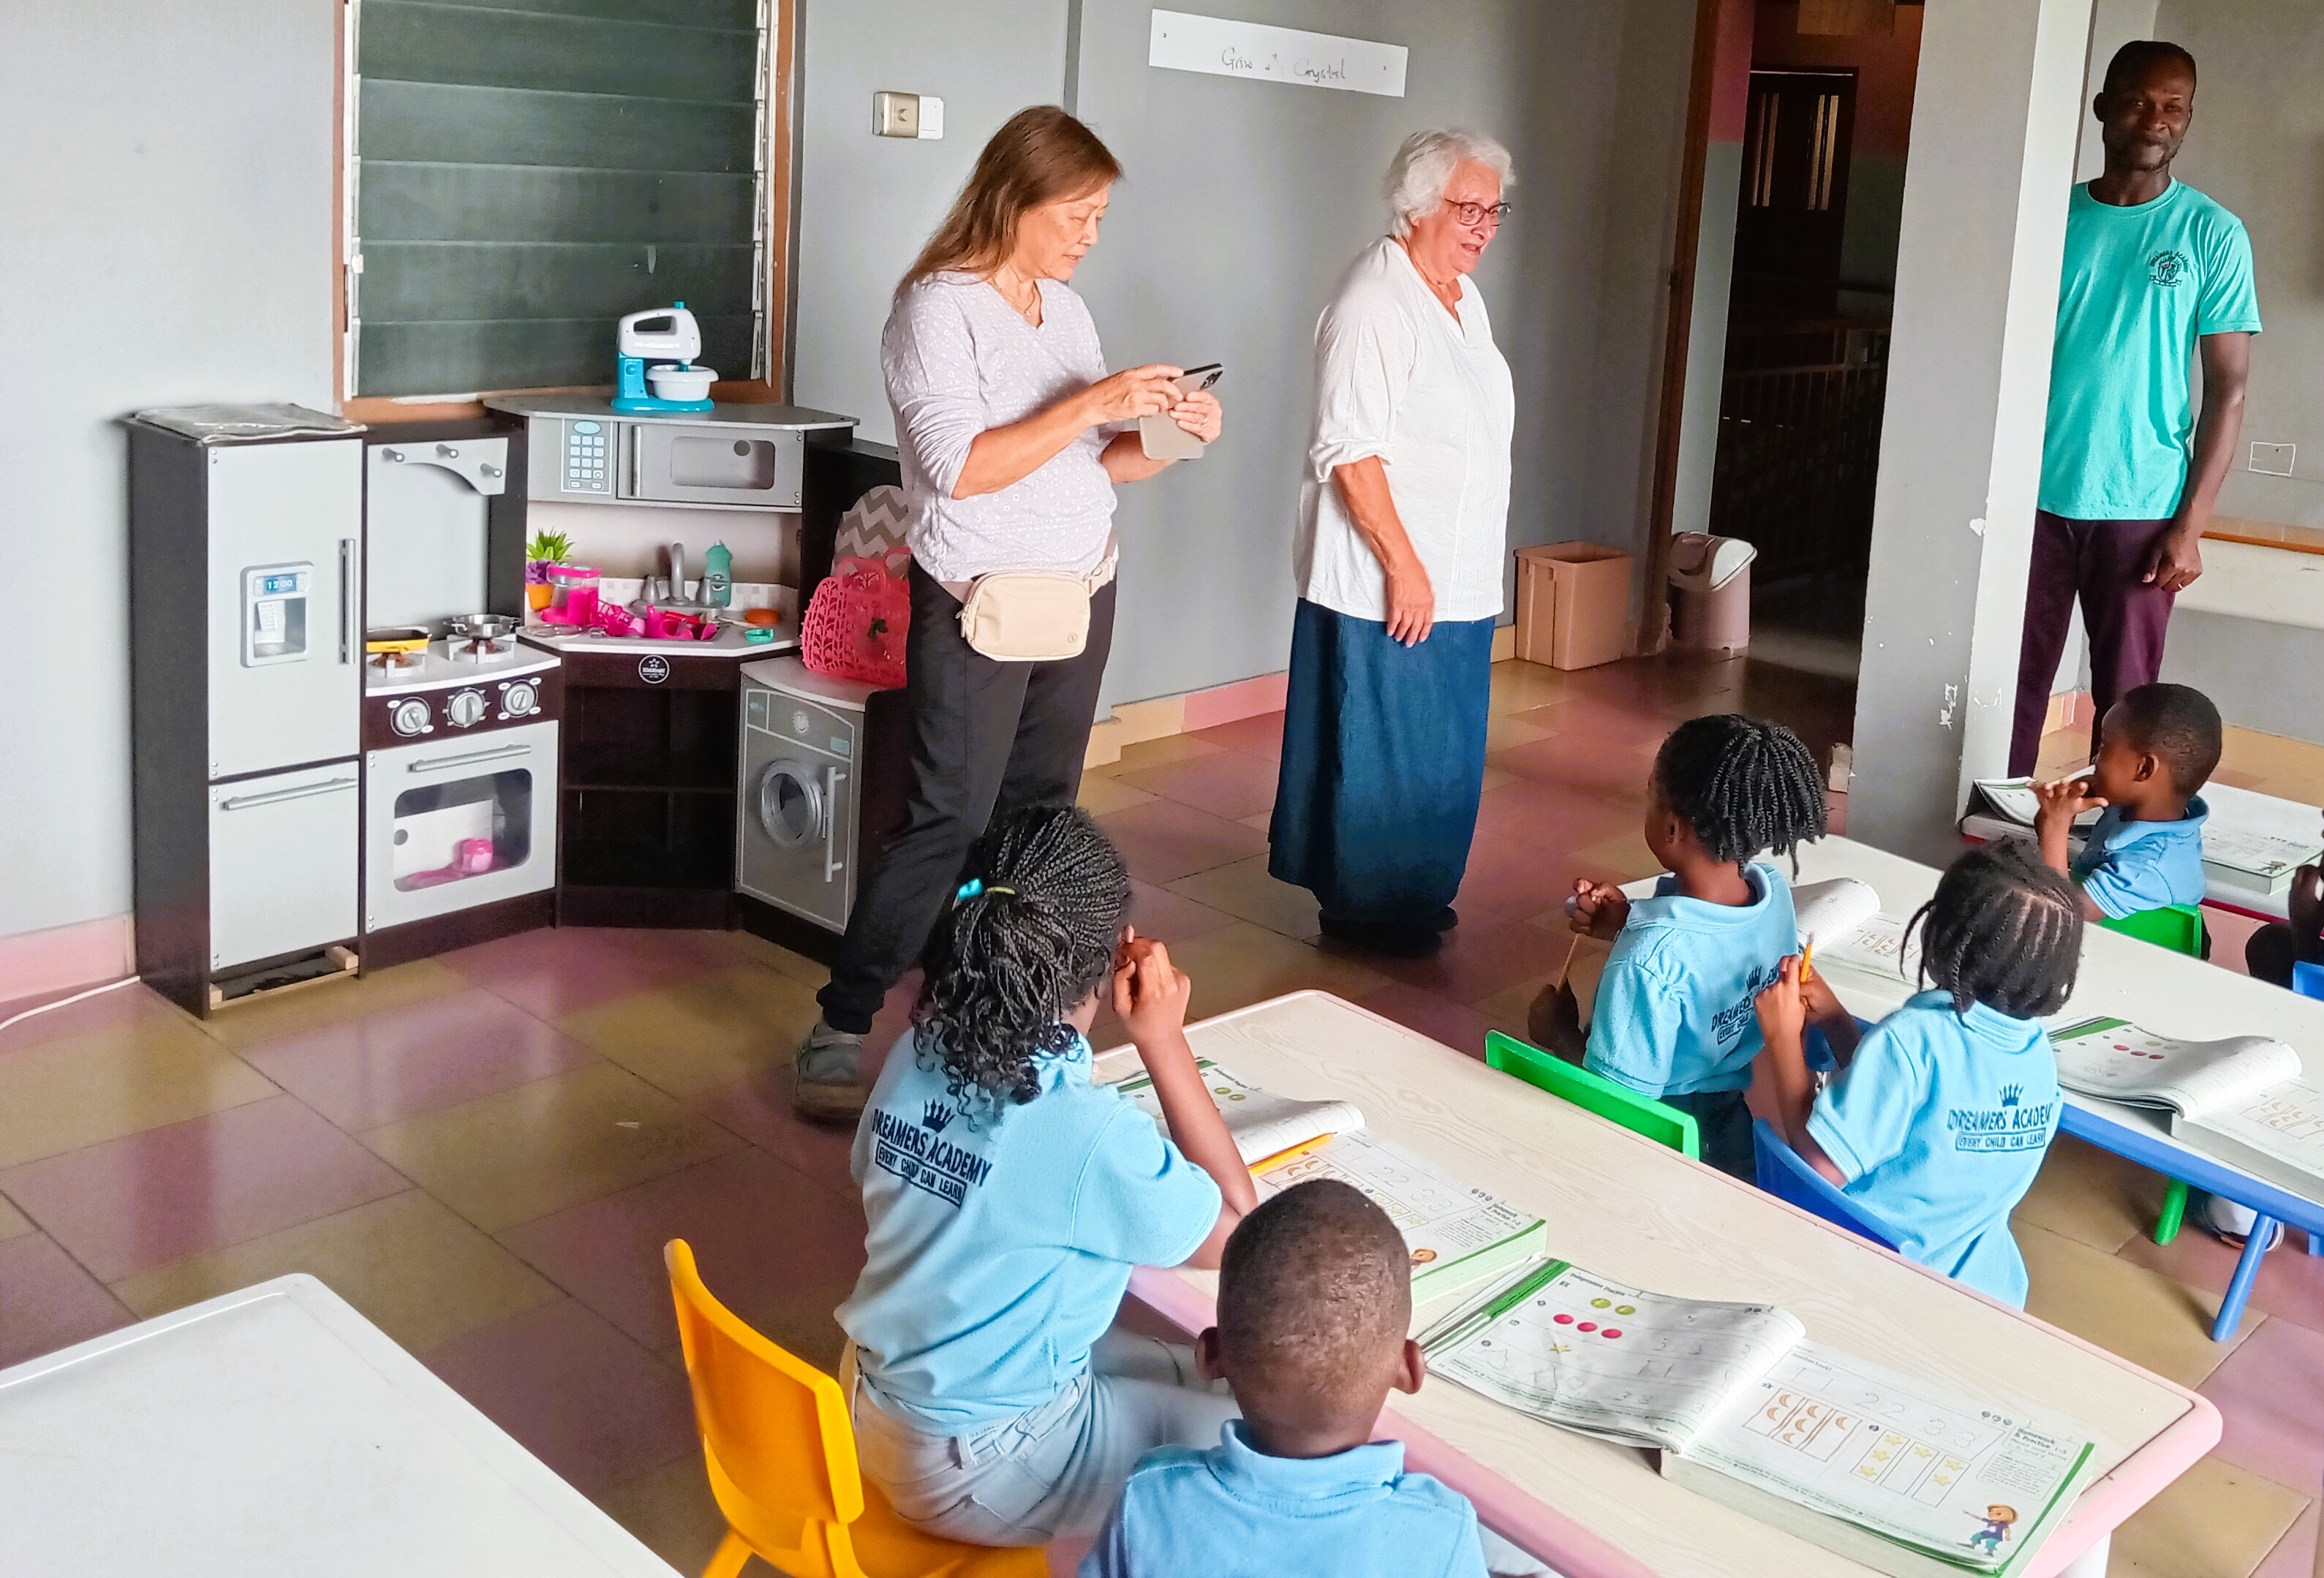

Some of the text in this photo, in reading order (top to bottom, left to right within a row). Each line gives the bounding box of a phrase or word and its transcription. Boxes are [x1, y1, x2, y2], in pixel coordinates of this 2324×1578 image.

[1985, 1136, 2006, 1148] CHILD
[2010, 1136, 2023, 1147] CAN
[925, 1136, 993, 1188] ACADEMY
[920, 1169, 936, 1188] CAN
[938, 1177, 963, 1203] LEARN
[2018, 1427, 2056, 1444] Homework
[2021, 1435, 2051, 1449] Practice
